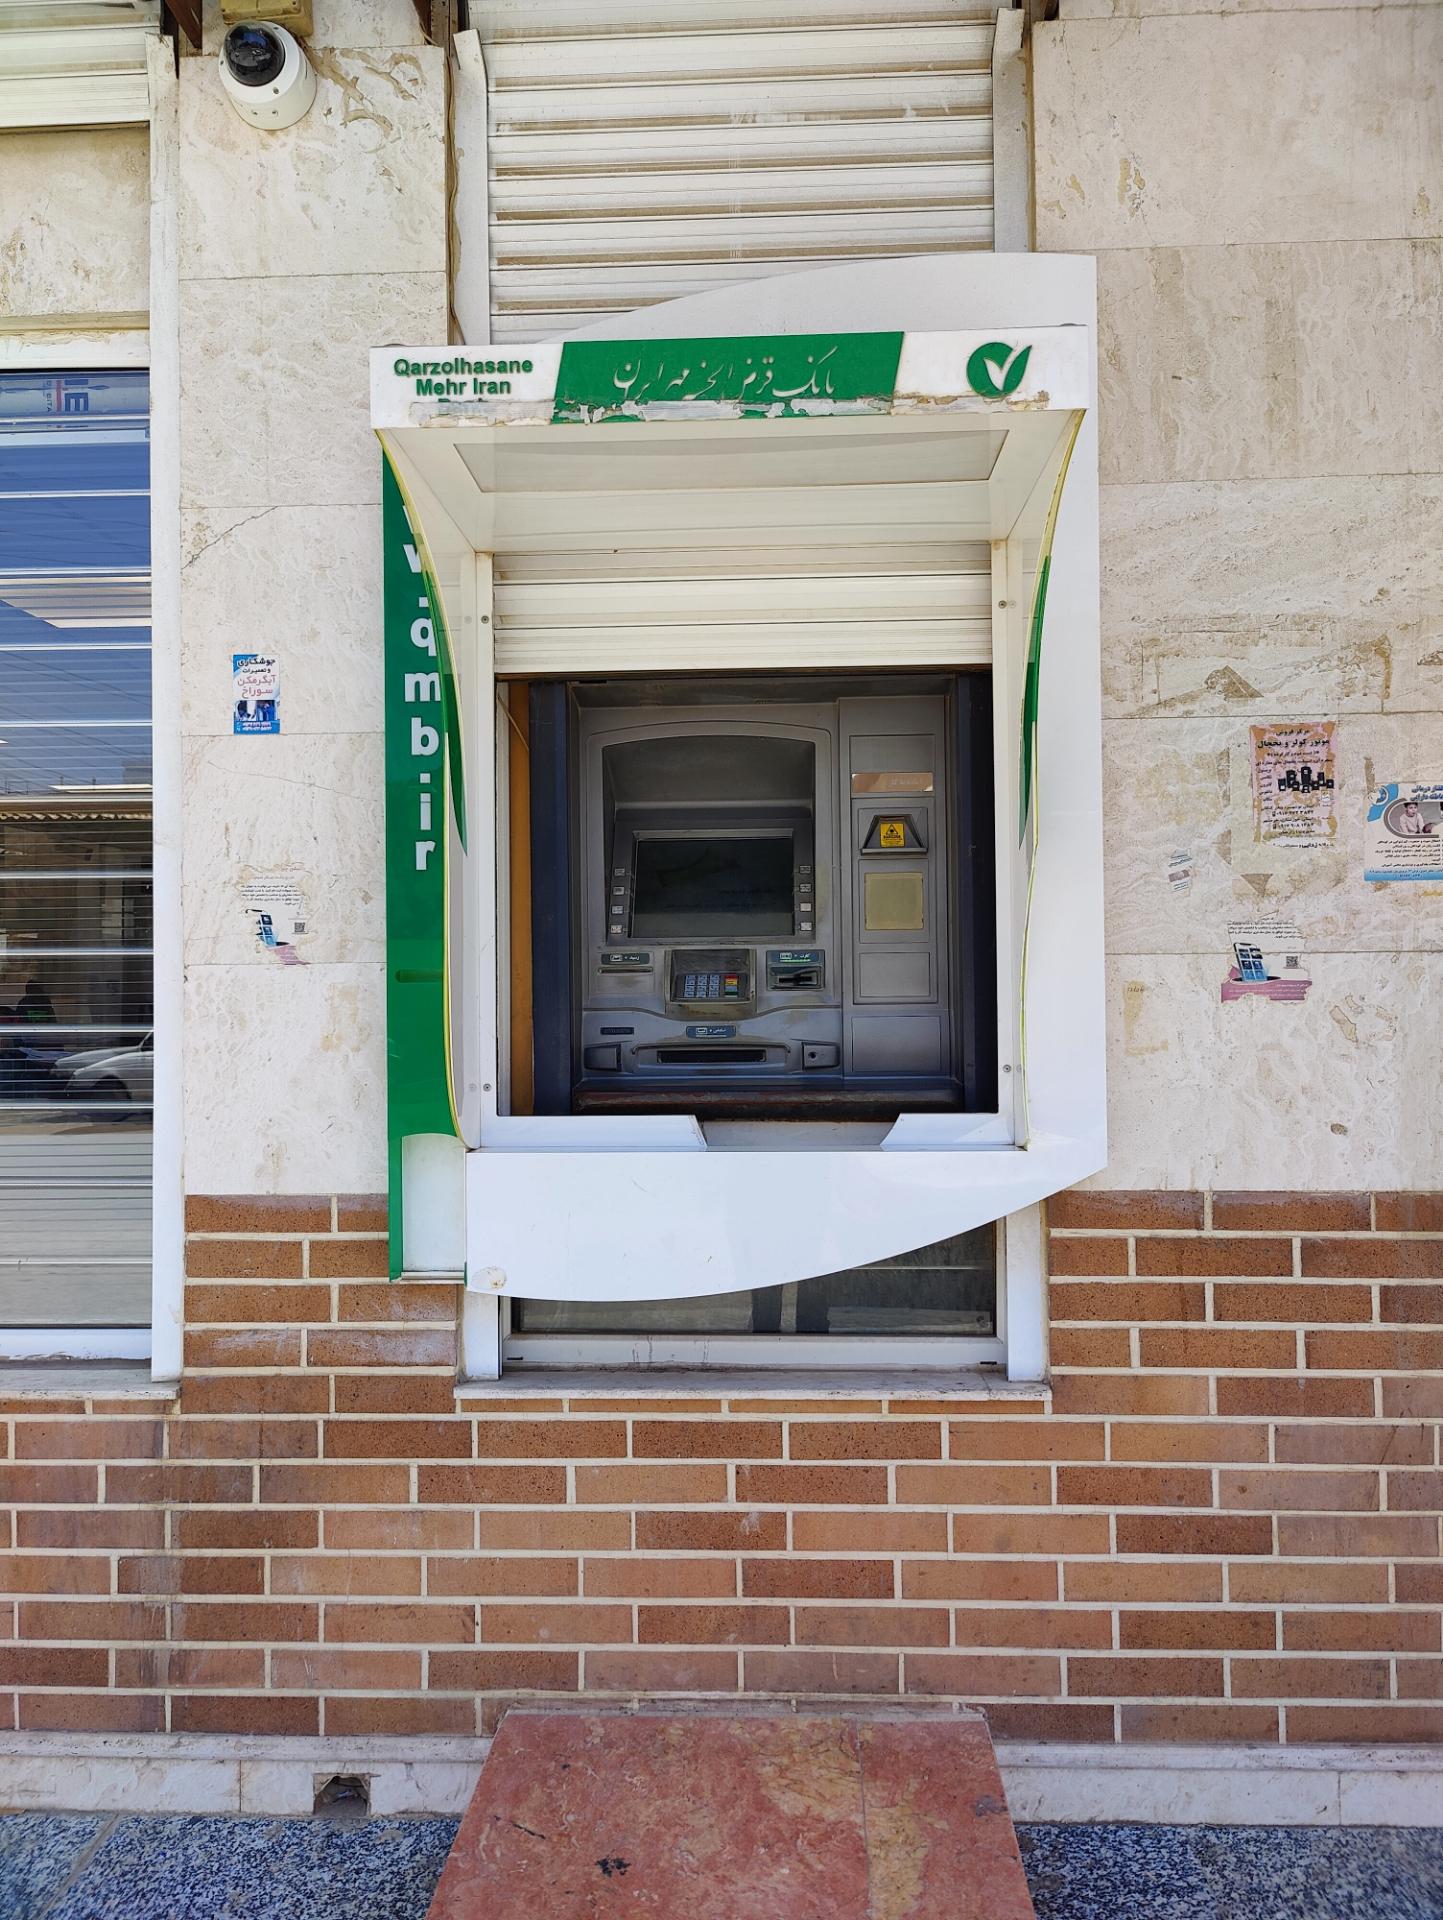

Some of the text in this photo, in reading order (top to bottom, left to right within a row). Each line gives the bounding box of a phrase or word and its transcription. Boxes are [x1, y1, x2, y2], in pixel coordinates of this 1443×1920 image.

[394, 357, 534, 377] Qarzolhasane
[416, 377, 512, 396] Mehr Iran
[237, 657, 276, 667] جوشکاری
[237, 674, 277, 686] آبگرمکن
